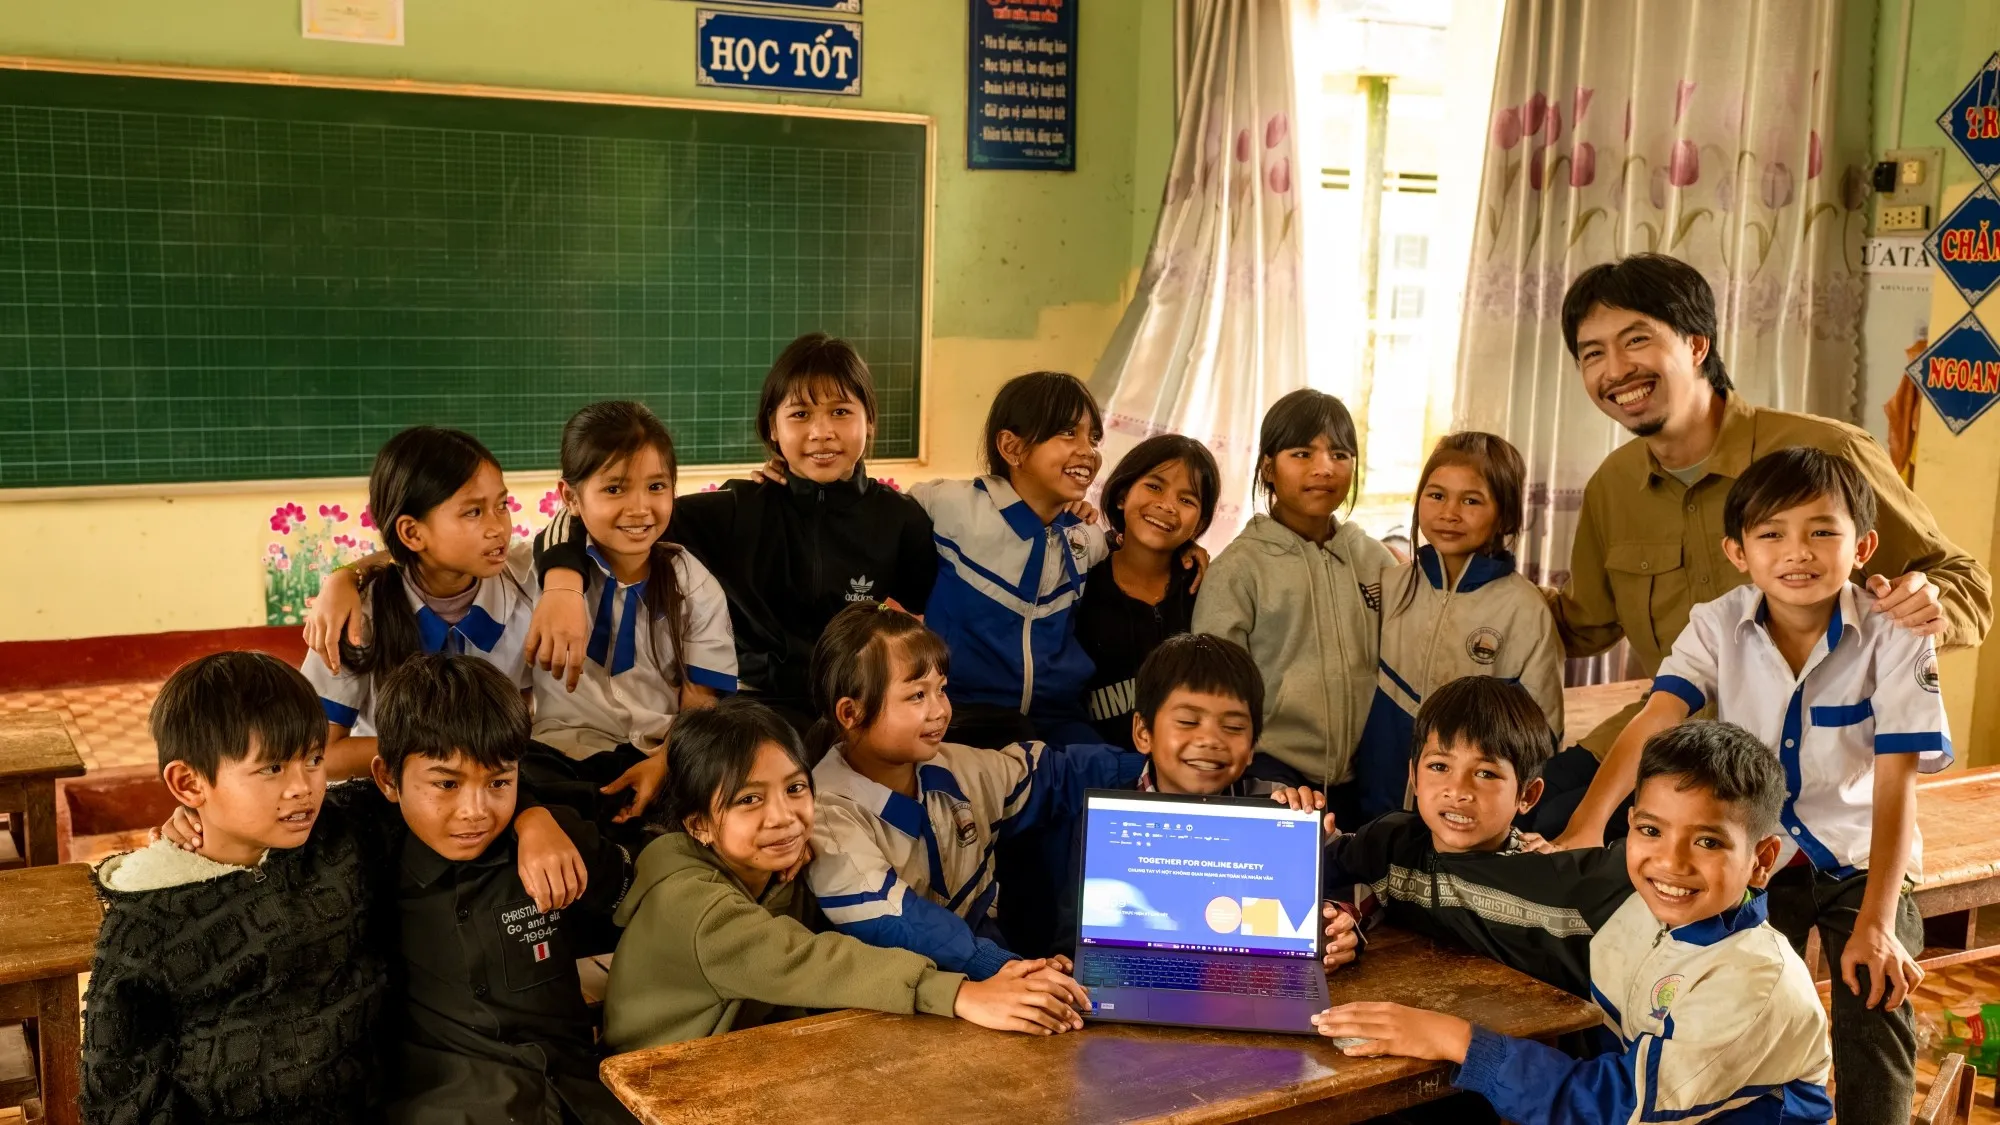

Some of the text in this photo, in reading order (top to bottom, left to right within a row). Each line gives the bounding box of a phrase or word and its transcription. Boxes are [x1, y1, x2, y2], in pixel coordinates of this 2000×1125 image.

[710, 28, 853, 81] HỌC TỐT
[1965, 106, 2000, 139] TR
[1927, 357, 2000, 393] NGOAN
[844, 592, 874, 602] adidas
[1138, 856, 1264, 871] TOGETHER FOR ONLINE SAFETY
[501, 904, 540, 924] CHRISTIA
[1472, 895, 1550, 925] CHRISTIAN BIOR
[507, 924, 522, 935] Go
[527, 915, 546, 929] and
